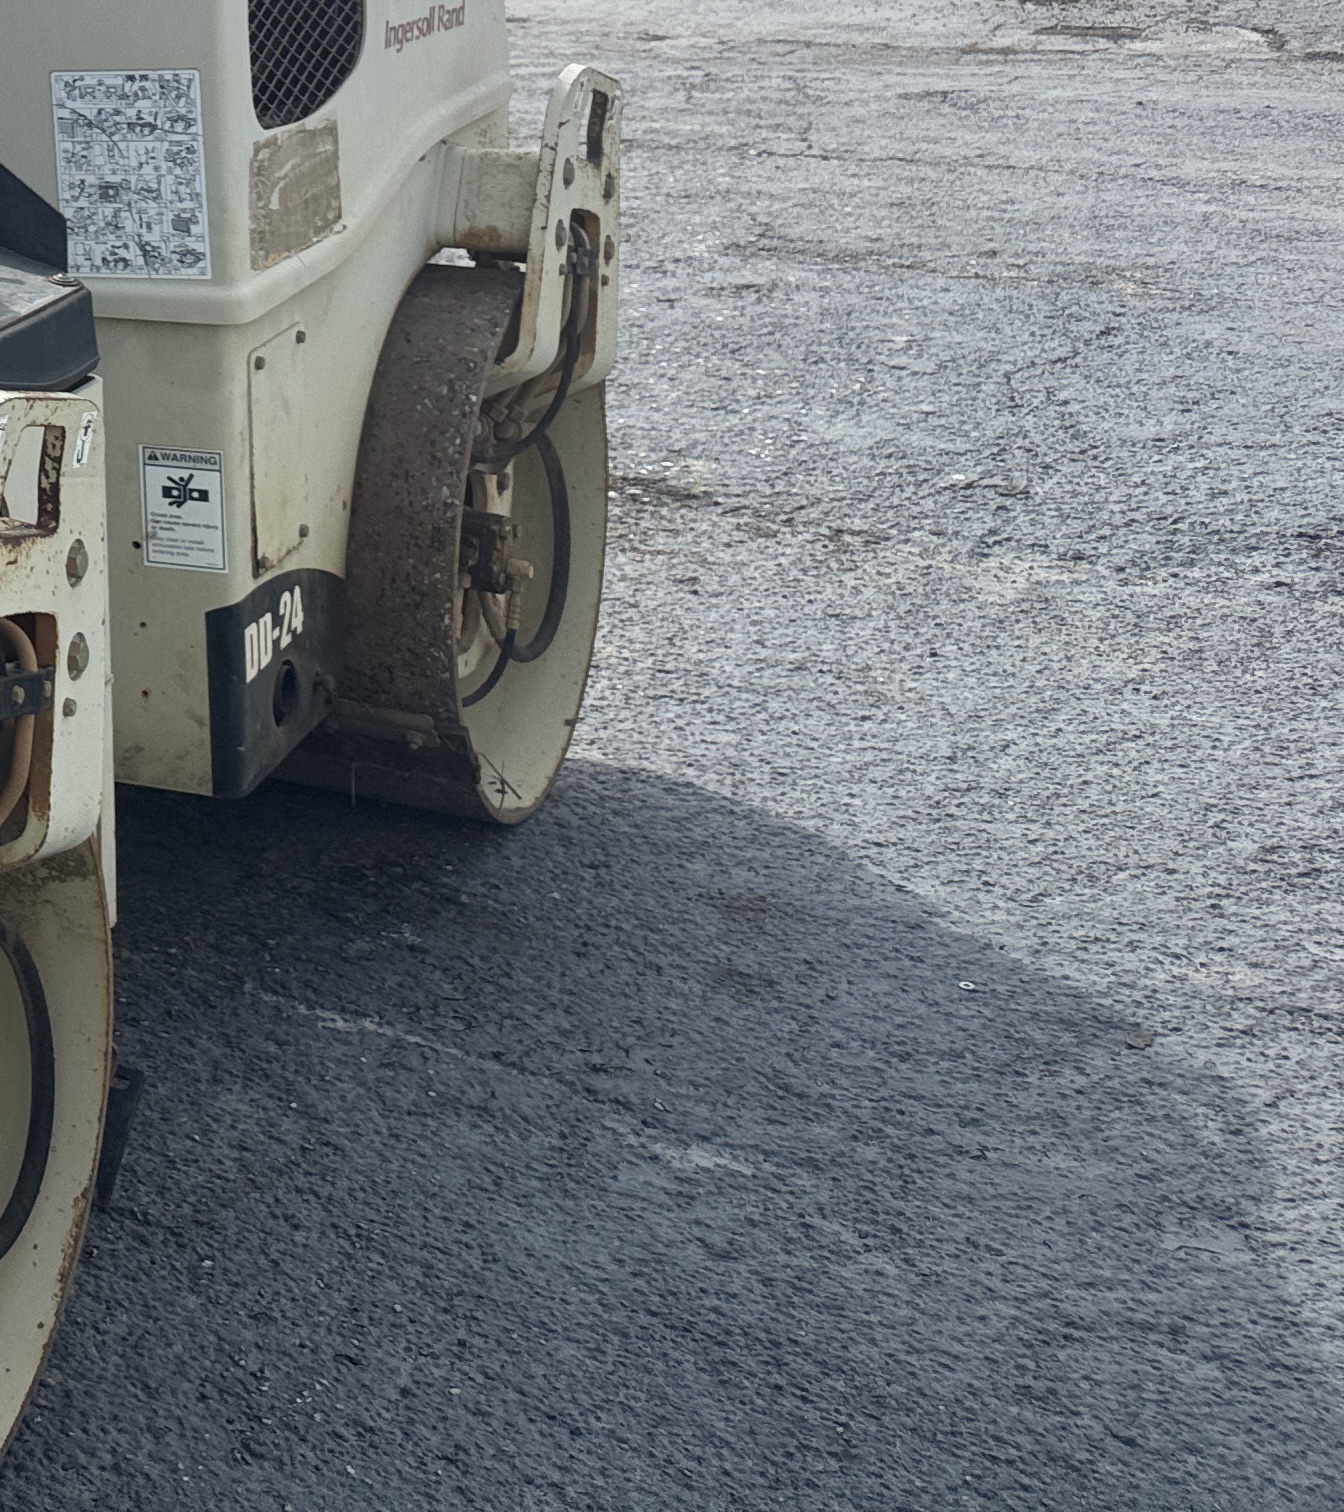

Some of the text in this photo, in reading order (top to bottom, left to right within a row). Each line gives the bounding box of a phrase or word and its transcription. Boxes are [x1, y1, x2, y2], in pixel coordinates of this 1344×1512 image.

[384, 5, 436, 54] Ingersoll
[159, 451, 218, 466] WARNING
[243, 584, 305, 684] DD-24
